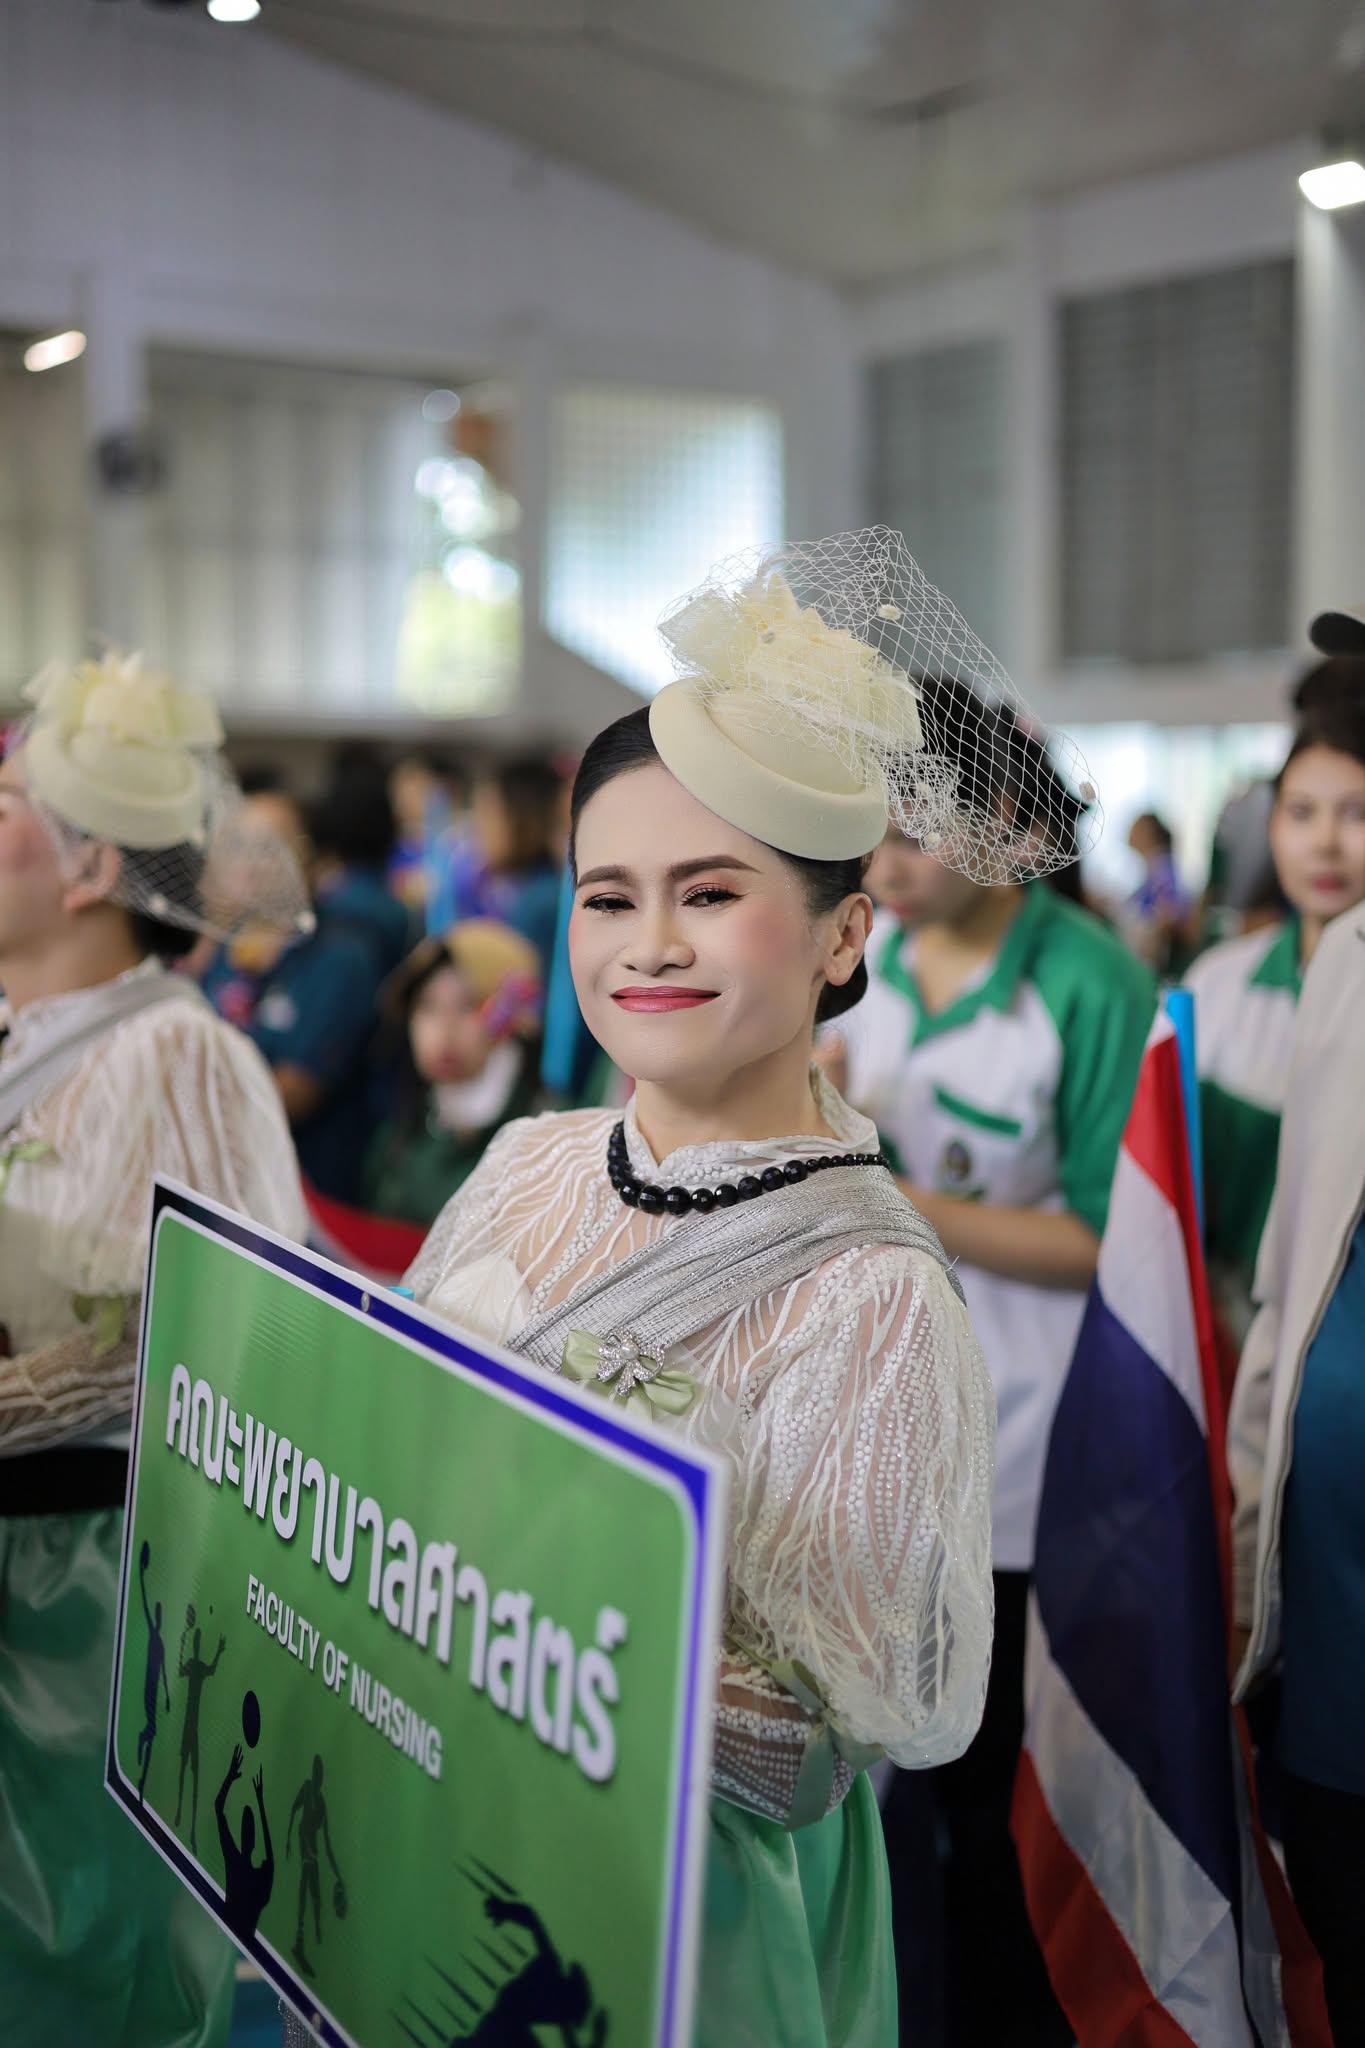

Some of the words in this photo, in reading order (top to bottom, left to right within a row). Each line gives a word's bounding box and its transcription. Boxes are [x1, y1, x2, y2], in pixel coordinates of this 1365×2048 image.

[165, 1363, 628, 1782] คณะพยาบาลศาสตร์
[246, 1573, 320, 1671] FACULTY
[322, 1640, 349, 1693] OF
[351, 1662, 442, 1780] NURSING
